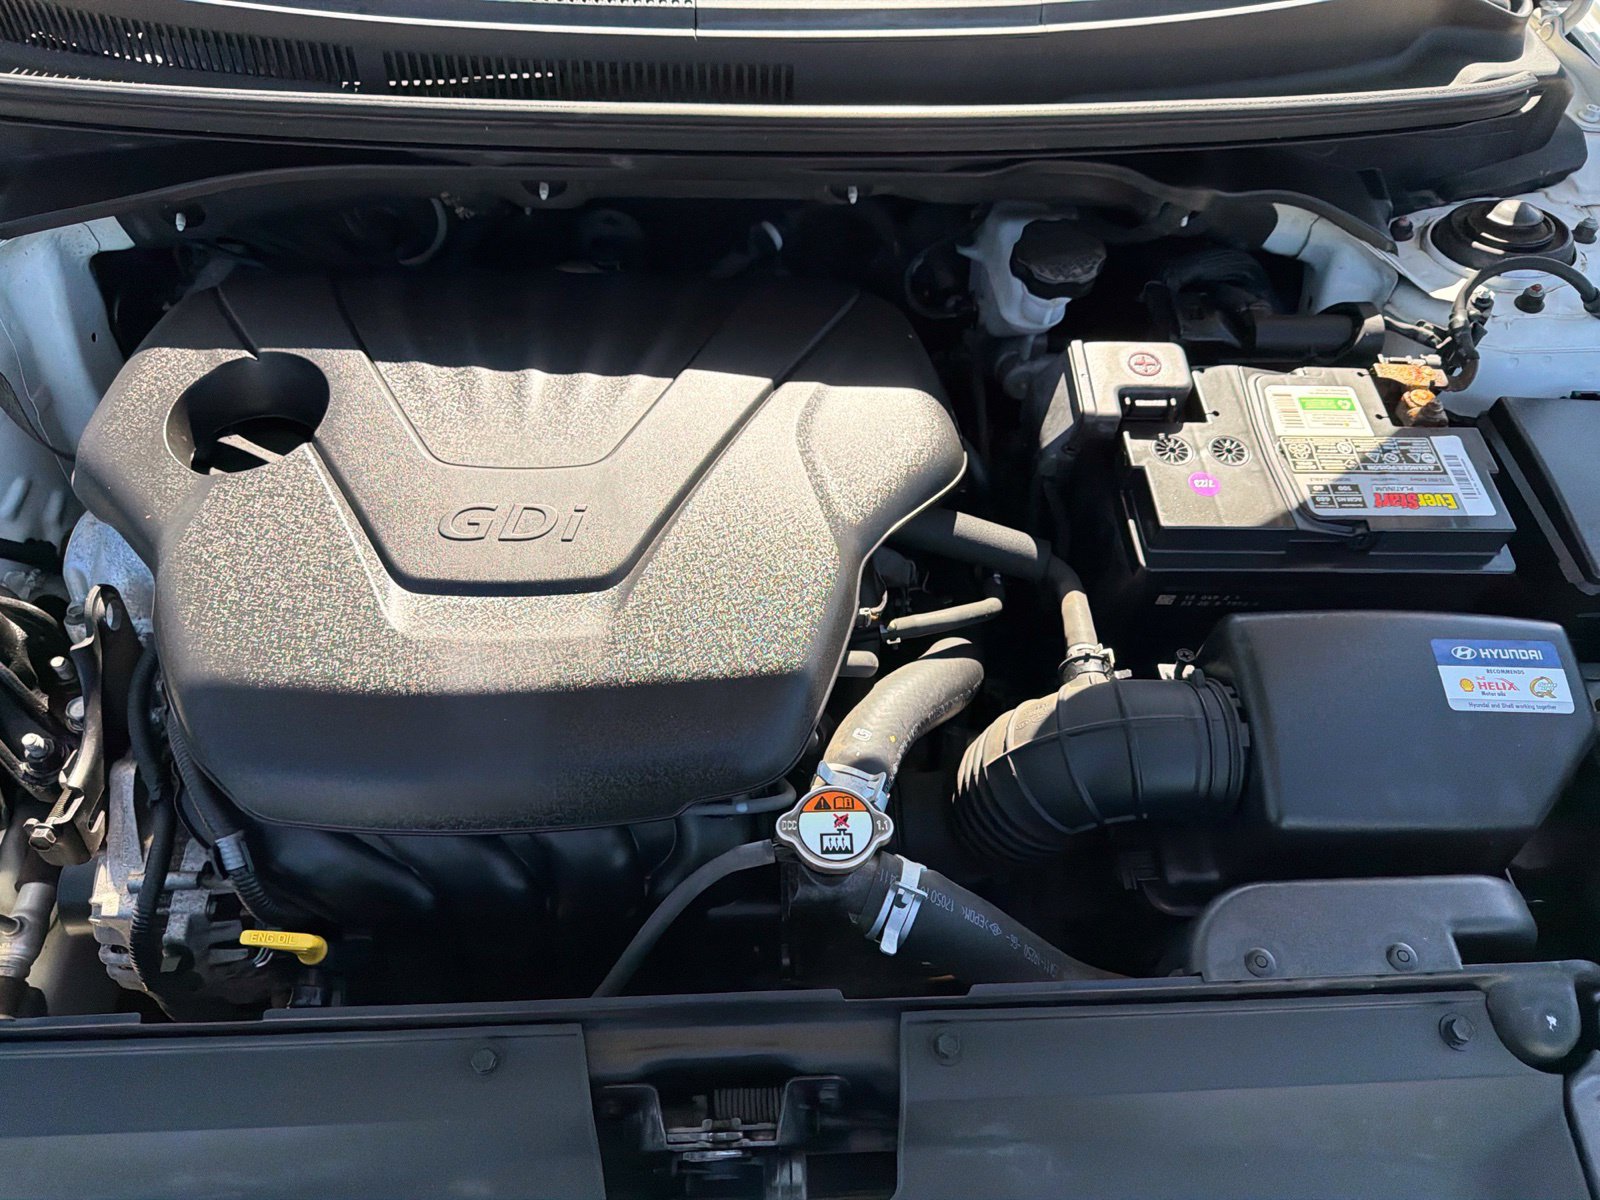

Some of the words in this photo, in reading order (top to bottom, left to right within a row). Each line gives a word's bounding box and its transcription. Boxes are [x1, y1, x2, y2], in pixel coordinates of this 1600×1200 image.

[1373, 492, 1459, 510] EverStart
[438, 503, 588, 542] GDi
[1479, 648, 1543, 660] HYUNDAI
[1477, 681, 1518, 691] HELIX
[251, 932, 274, 942] ENG
[278, 934, 296, 944] OIL
